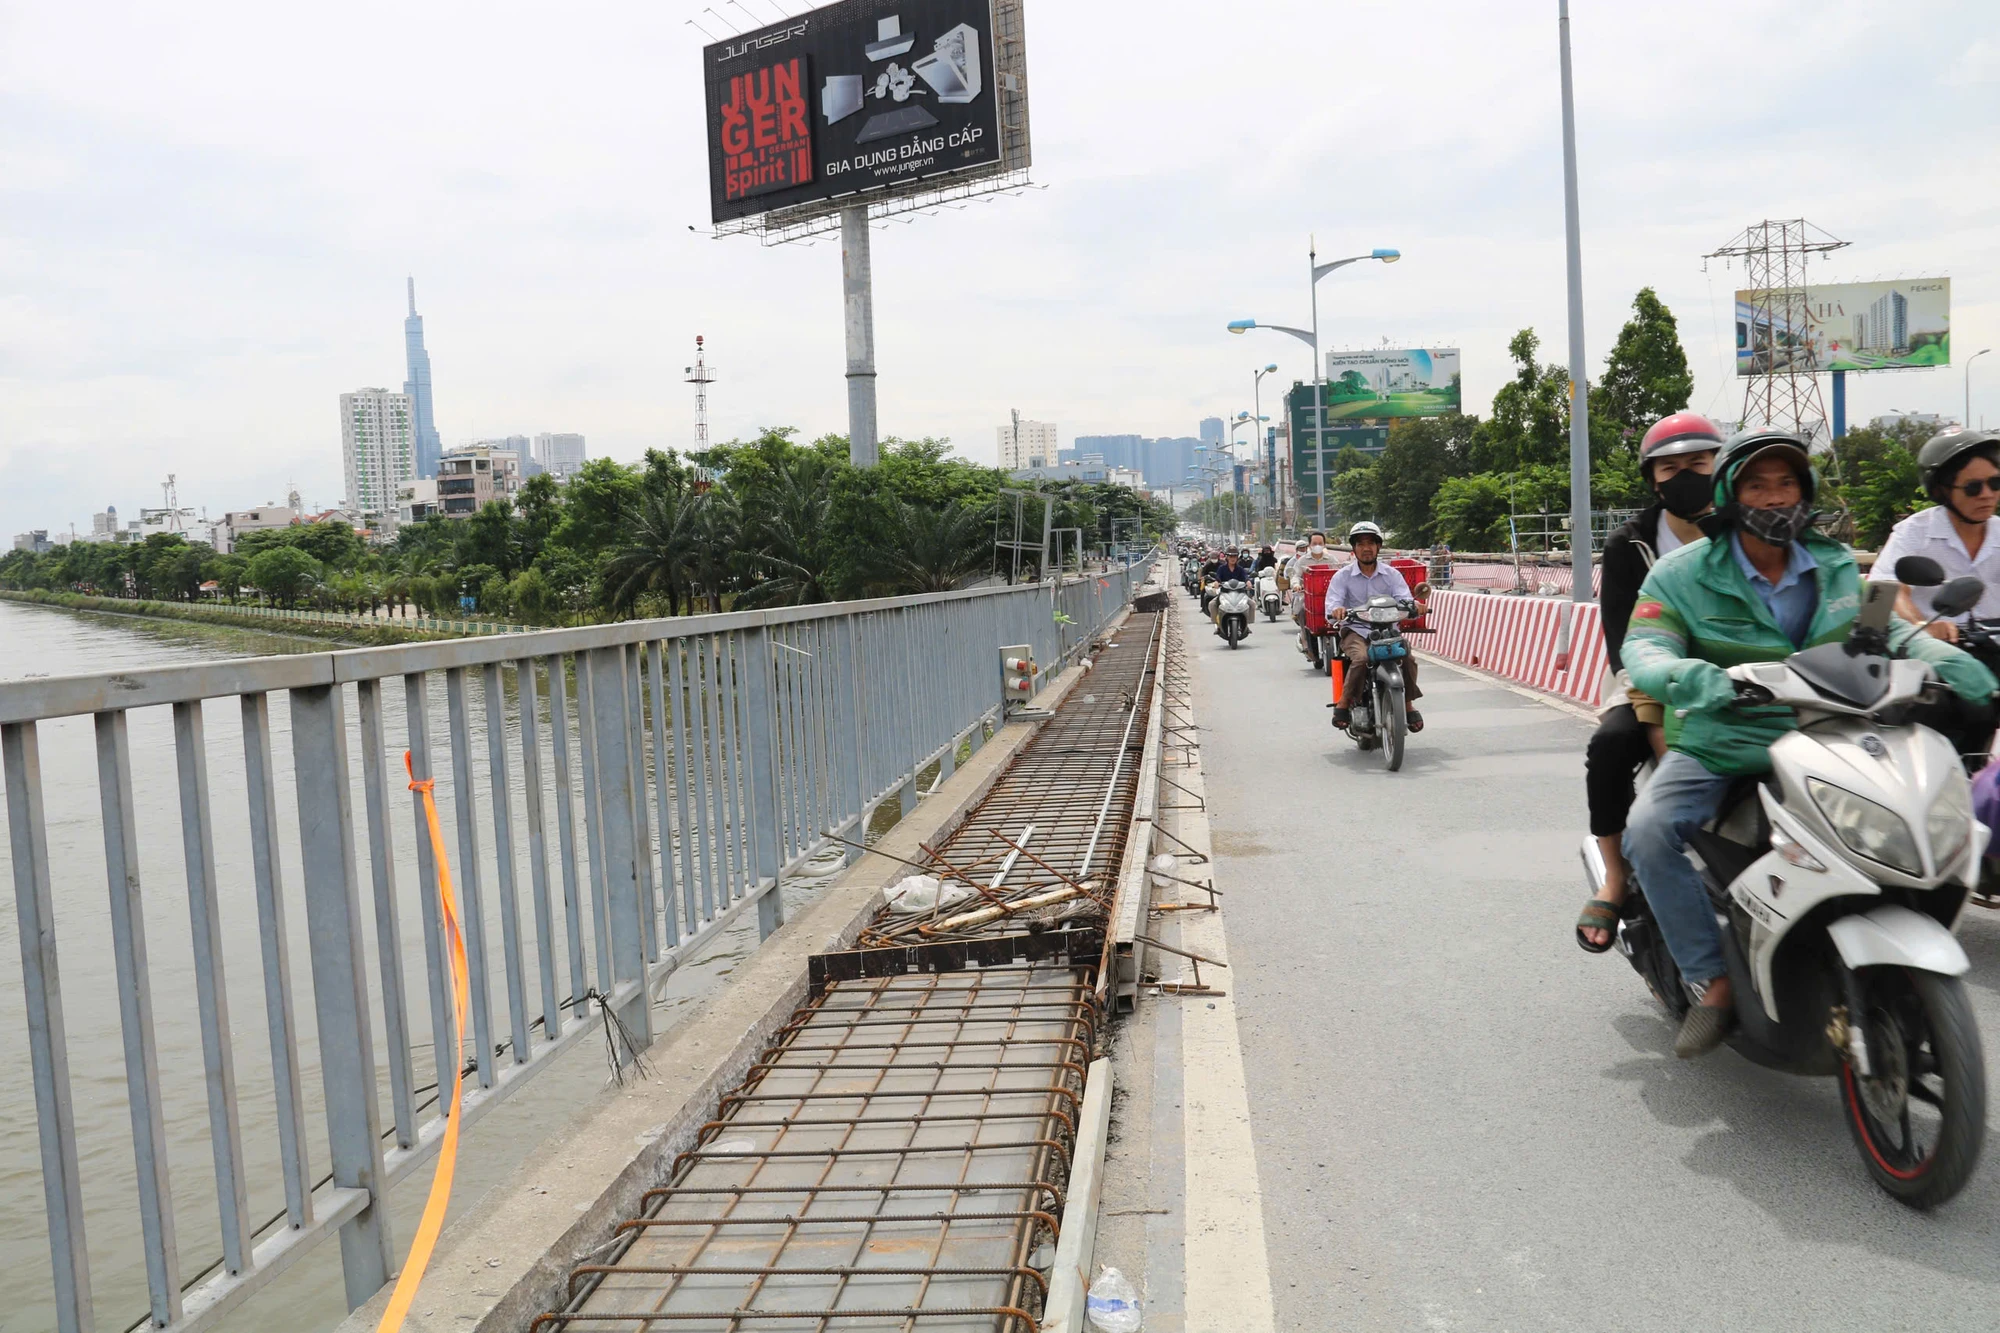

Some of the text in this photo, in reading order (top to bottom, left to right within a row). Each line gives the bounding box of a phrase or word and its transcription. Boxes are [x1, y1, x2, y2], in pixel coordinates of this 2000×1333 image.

[718, 24, 806, 62] JUNGER
[721, 58, 800, 119] JUN
[722, 98, 809, 156] GER
[826, 159, 851, 176] GIA
[854, 148, 897, 170] DỤNG
[900, 135, 945, 159] ĐẲNG
[949, 122, 983, 148] CẤP
[726, 156, 785, 199] spirit
[874, 156, 934, 177] www.junger.vn
